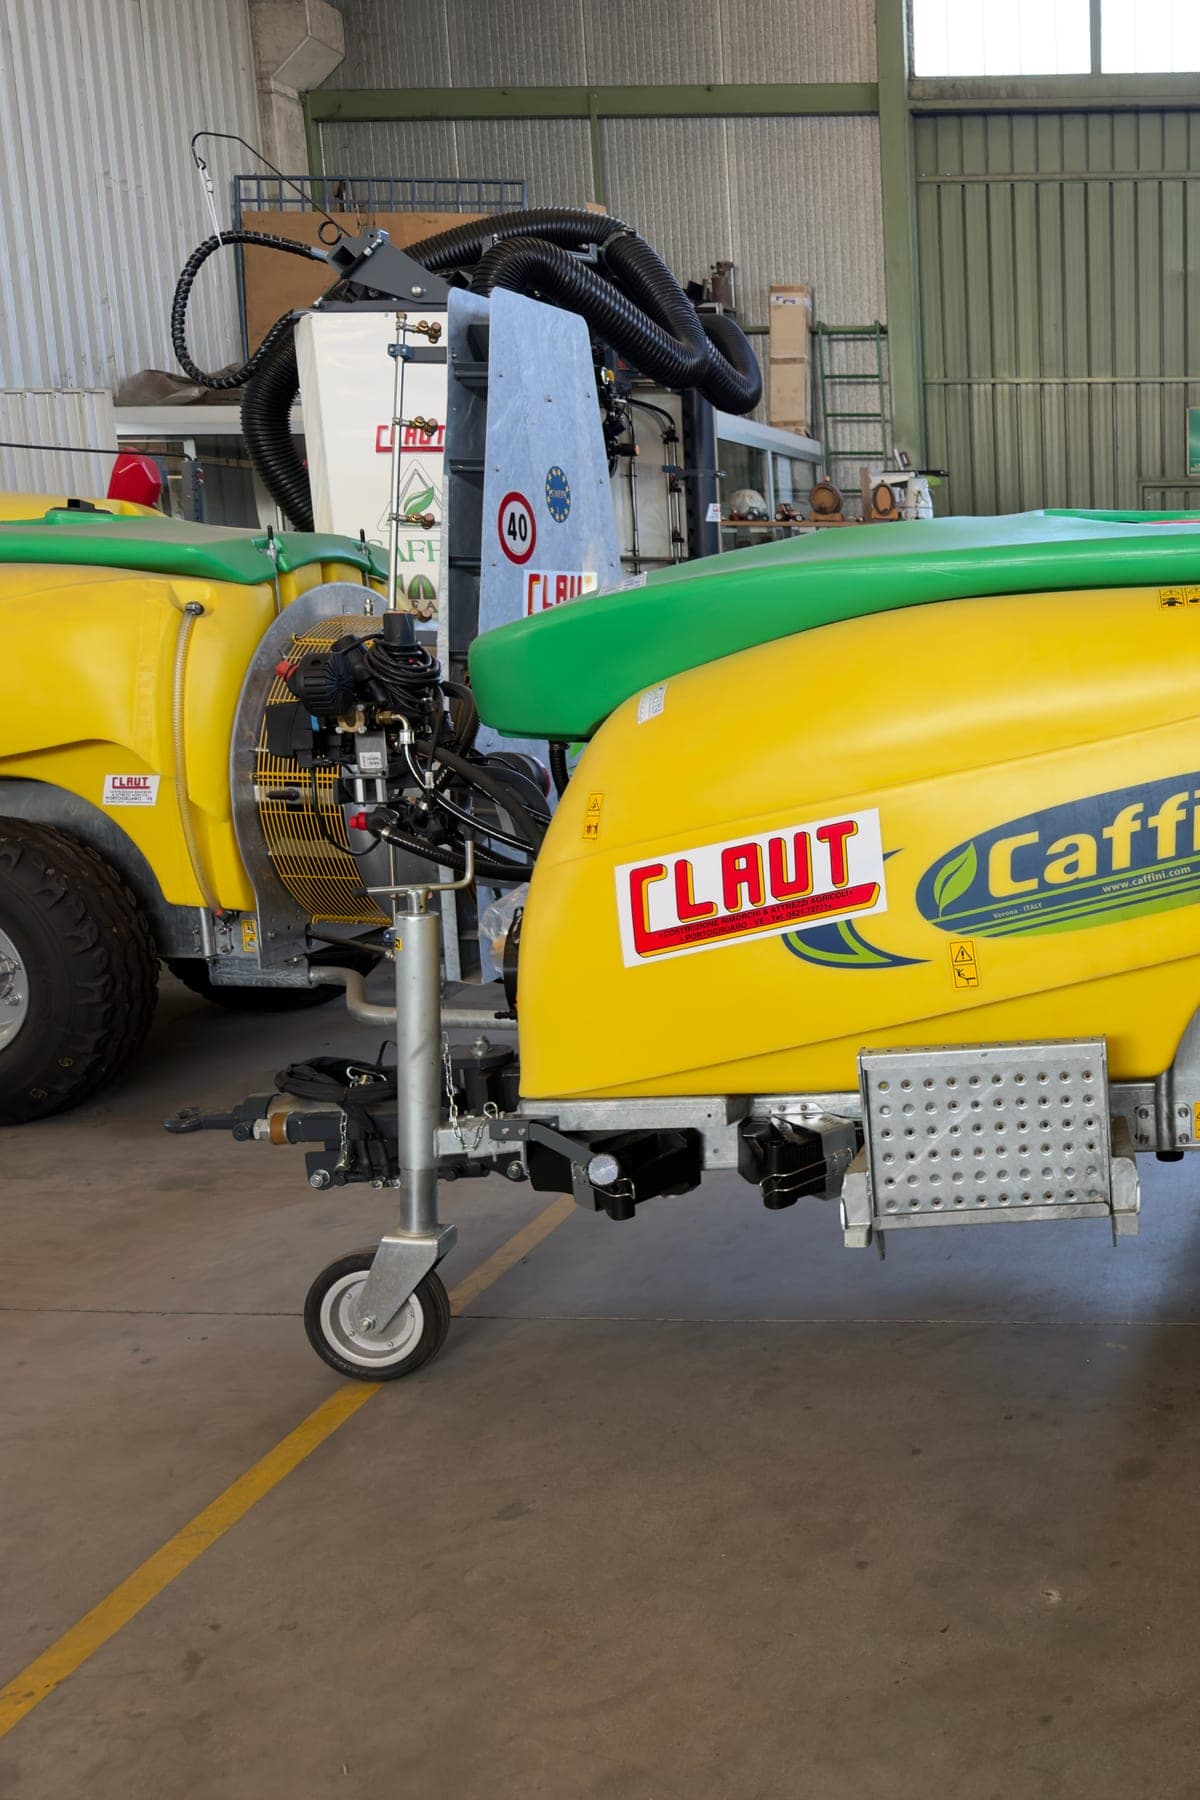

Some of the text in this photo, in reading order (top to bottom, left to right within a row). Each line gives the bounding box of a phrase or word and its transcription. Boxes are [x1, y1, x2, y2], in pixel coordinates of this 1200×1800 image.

[507, 511, 528, 542] 40
[112, 776, 151, 789] CLAUT
[629, 819, 881, 959] CLAUT
[1101, 865, 1191, 894] www.caffini.com
[992, 908, 1019, 919] Verona
[1023, 902, 1043, 913] ITALY
